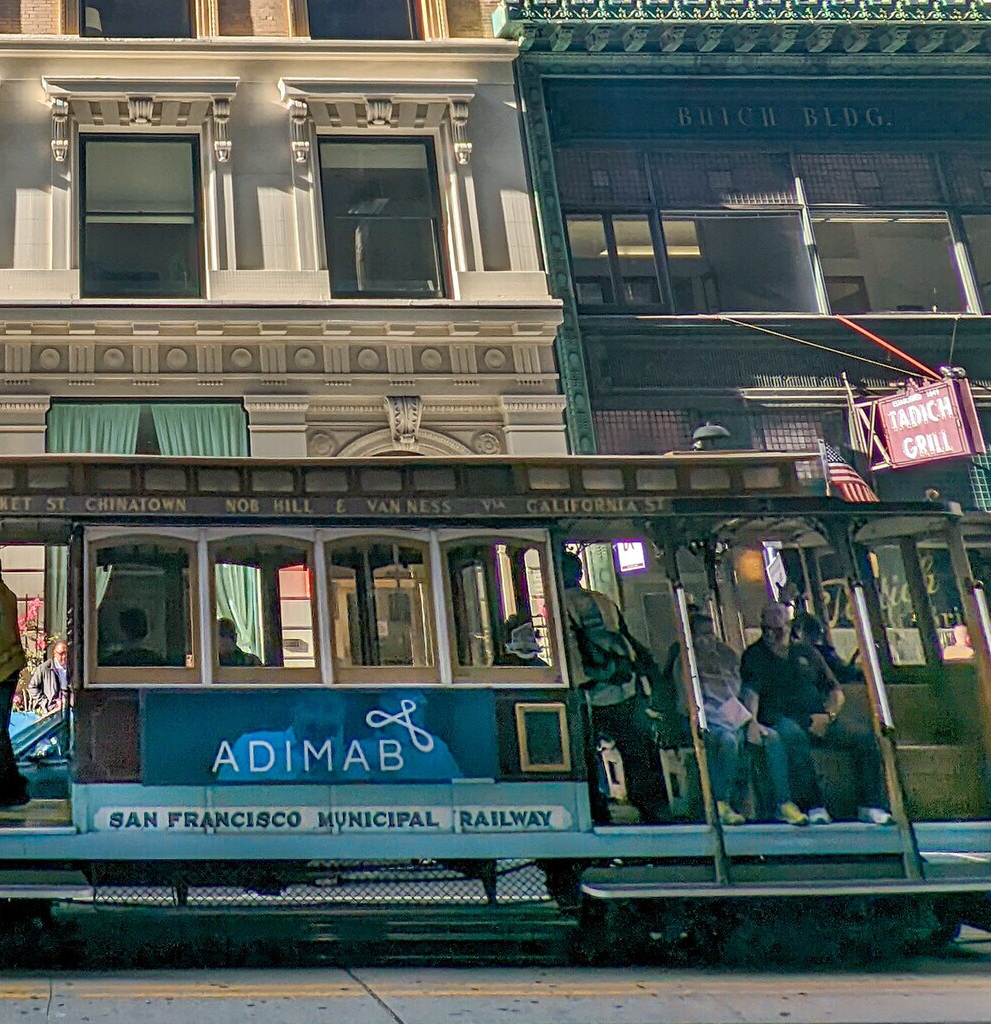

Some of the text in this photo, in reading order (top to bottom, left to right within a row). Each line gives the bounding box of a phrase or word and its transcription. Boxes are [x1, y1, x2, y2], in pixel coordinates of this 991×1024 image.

[802, 106, 892, 127] BLDG.
[887, 396, 954, 431] TADICH
[902, 430, 954, 460] GRILL
[85, 498, 187, 513] CHINATOWN
[225, 499, 260, 514] NOB
[274, 499, 314, 514] HILL
[367, 499, 401, 514] VAN
[407, 499, 452, 514] NESS
[526, 499, 638, 514] CALIFORNIA
[212, 739, 404, 773] ADIMAB
[109, 810, 553, 829] SAN FRANCISCO MUNICIPAL RAILWAY
